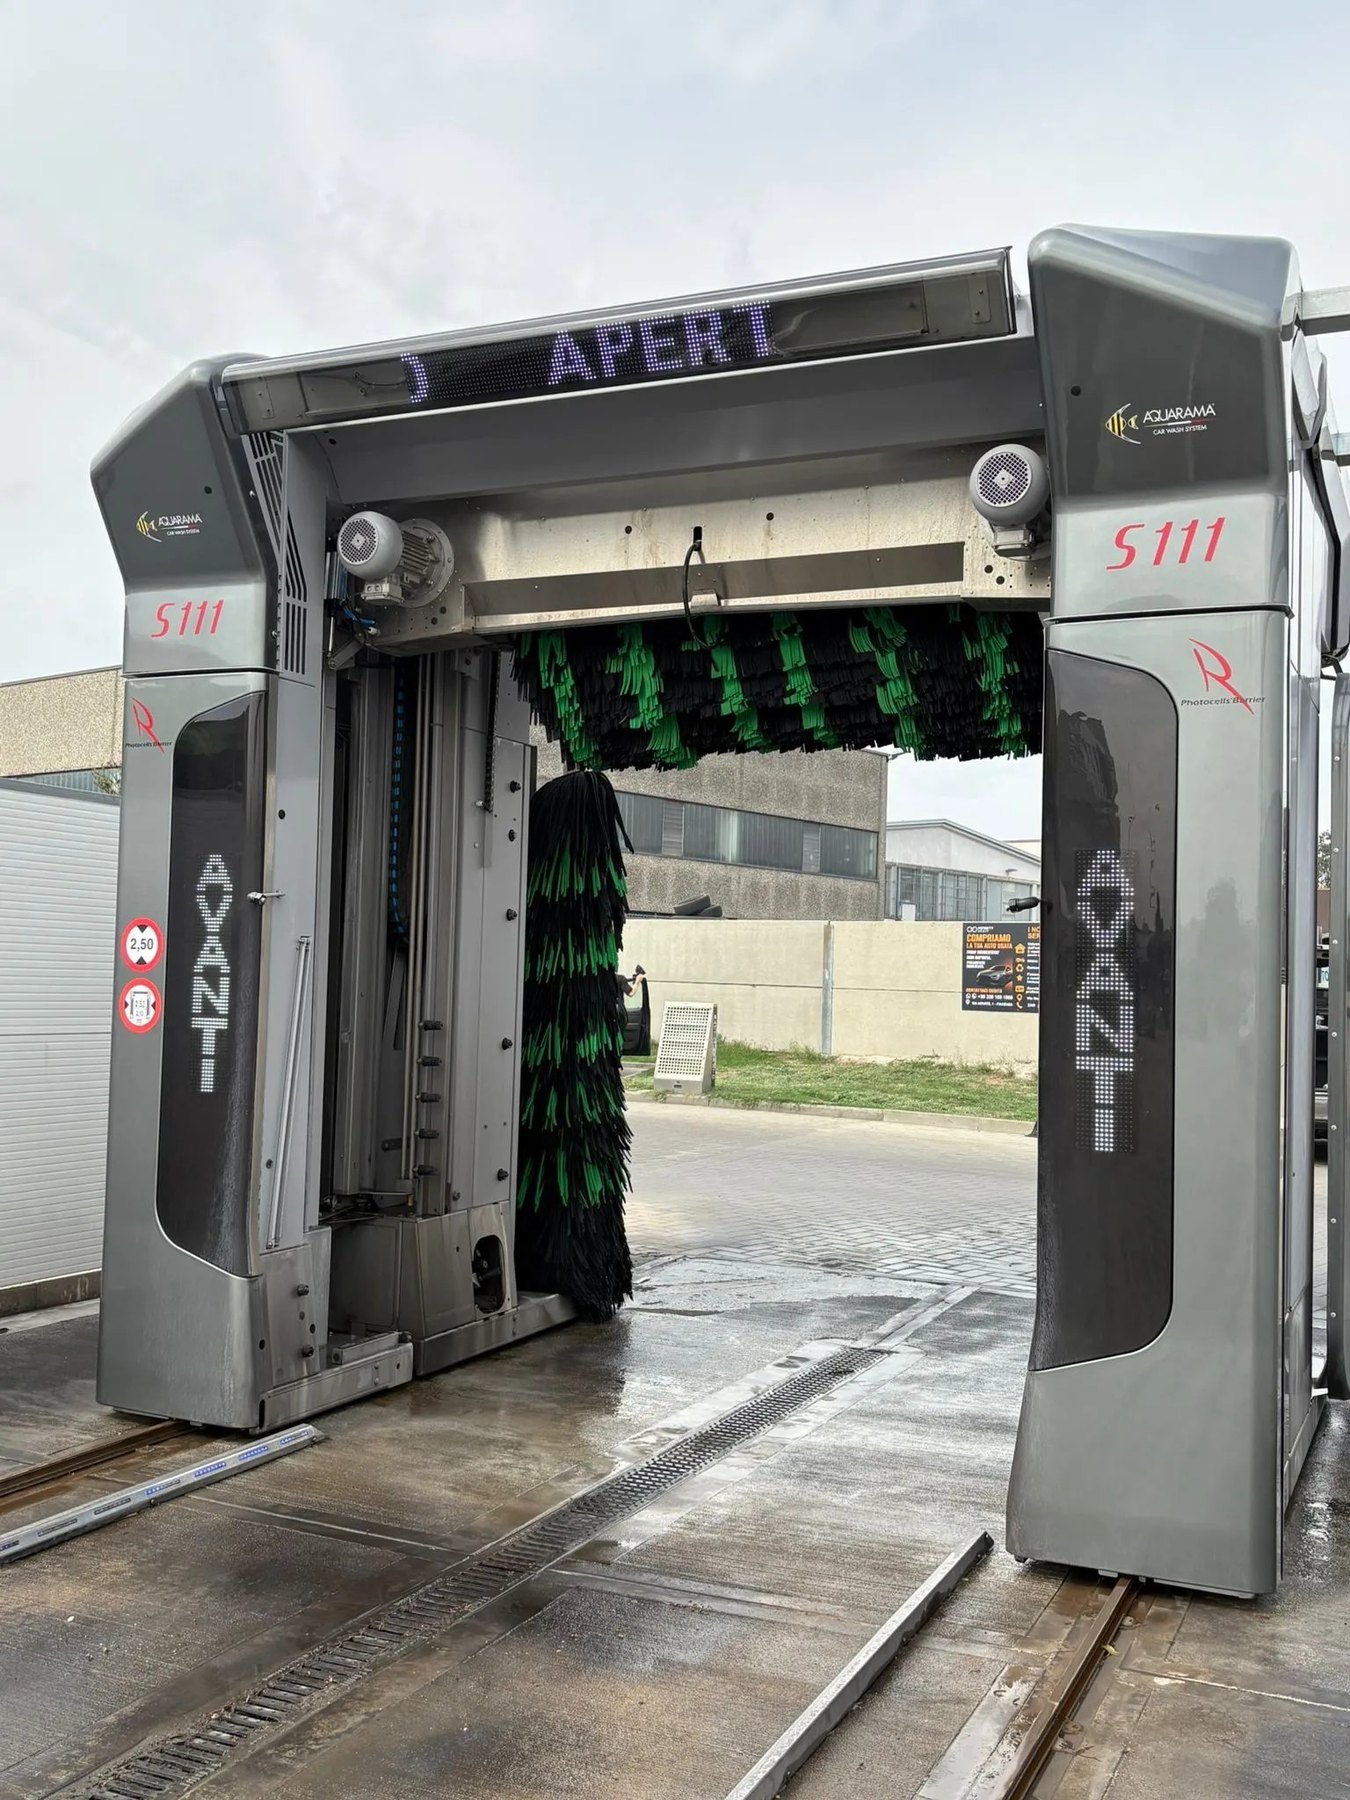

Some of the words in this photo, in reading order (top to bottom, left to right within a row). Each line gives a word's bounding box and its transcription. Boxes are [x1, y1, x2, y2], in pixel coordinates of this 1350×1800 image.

[548, 300, 770, 386] APERT
[1142, 404, 1216, 424] AQUARAMA
[1166, 426, 1184, 434] WASH
[1185, 424, 1207, 432] SYSTEM
[158, 513, 203, 526] AQUARAMA
[130, 938, 154, 952] 2,50
[966, 934, 1011, 942] COMPRIAMO
[191, 854, 233, 1093] AVANTI
[1076, 849, 1135, 1152] AVANTI
